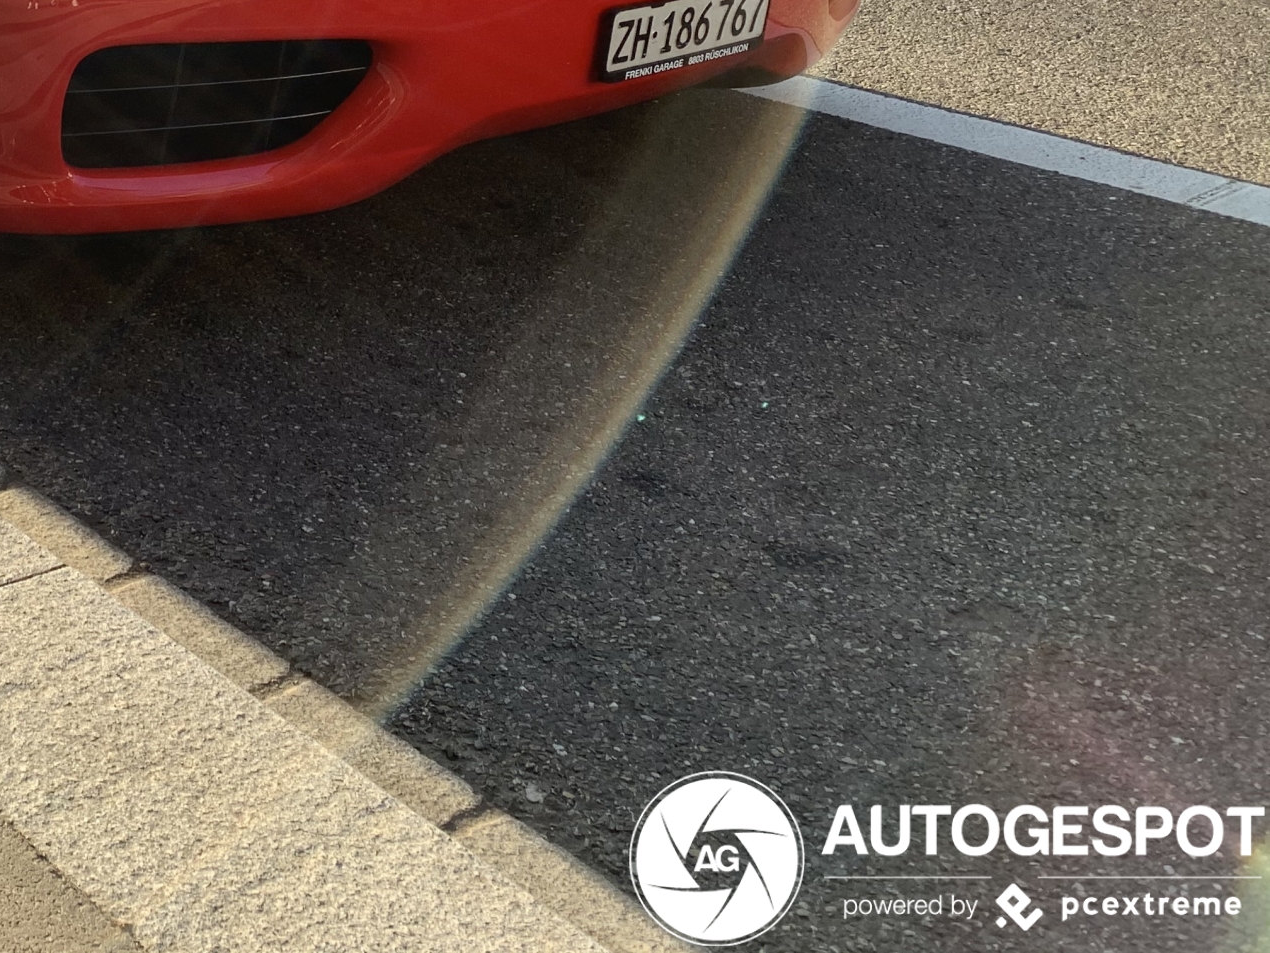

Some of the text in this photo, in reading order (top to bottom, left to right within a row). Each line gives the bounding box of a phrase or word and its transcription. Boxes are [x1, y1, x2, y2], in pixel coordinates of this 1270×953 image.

[625, 65, 653, 81] FRENKI
[653, 58, 685, 74] GARAGE
[705, 43, 749, 62] RÜSCHLIKON
